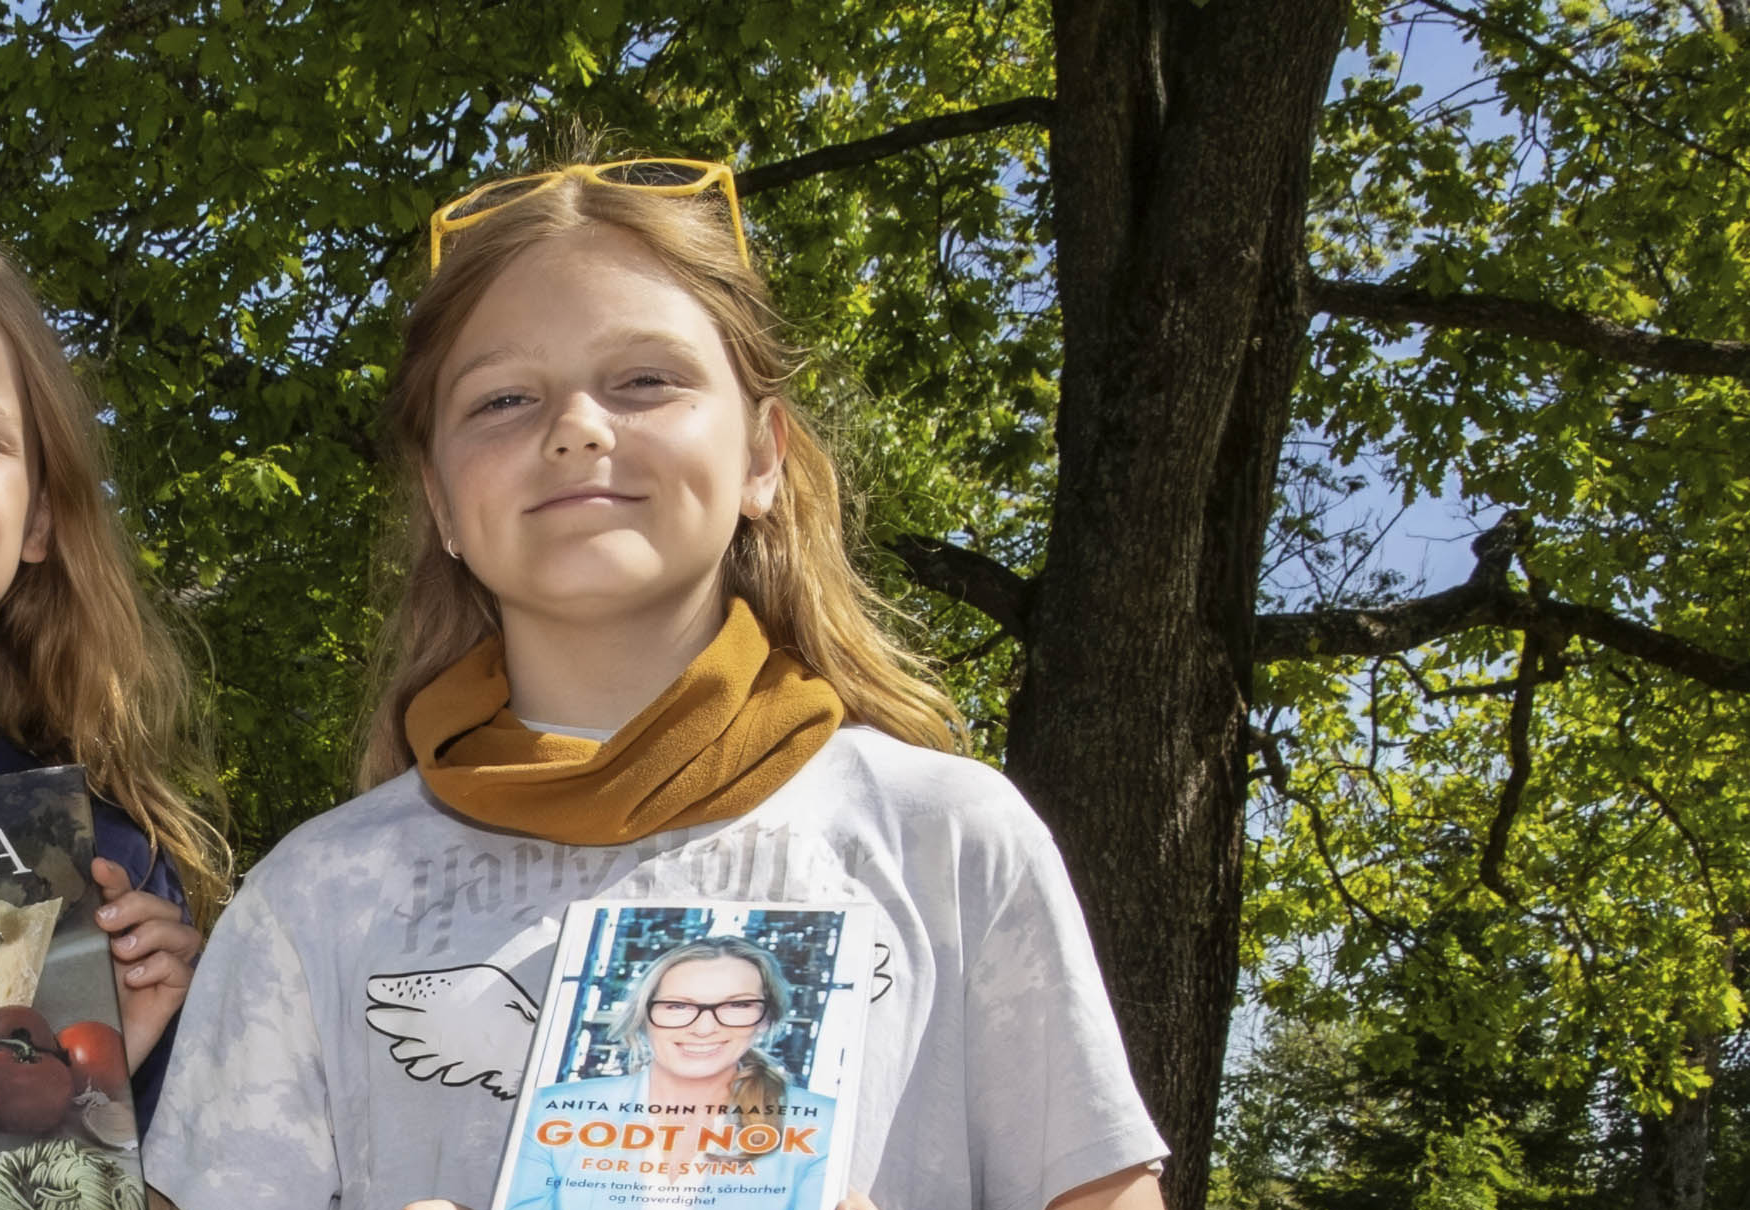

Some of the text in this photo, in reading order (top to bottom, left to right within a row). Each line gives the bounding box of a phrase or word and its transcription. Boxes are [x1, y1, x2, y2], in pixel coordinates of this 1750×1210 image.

[546, 1100, 818, 1117] ANITA KROHN TRAASETH
[536, 1119, 819, 1155] GODT NOK
[582, 1158, 756, 1176] FOR DE SVINA
[566, 1177, 607, 1190] leders
[611, 1180, 653, 1192] tanker
[658, 1184, 680, 1193] om
[717, 1182, 787, 1195] sårbarhet
[609, 1194, 716, 1207] og troverdighet
